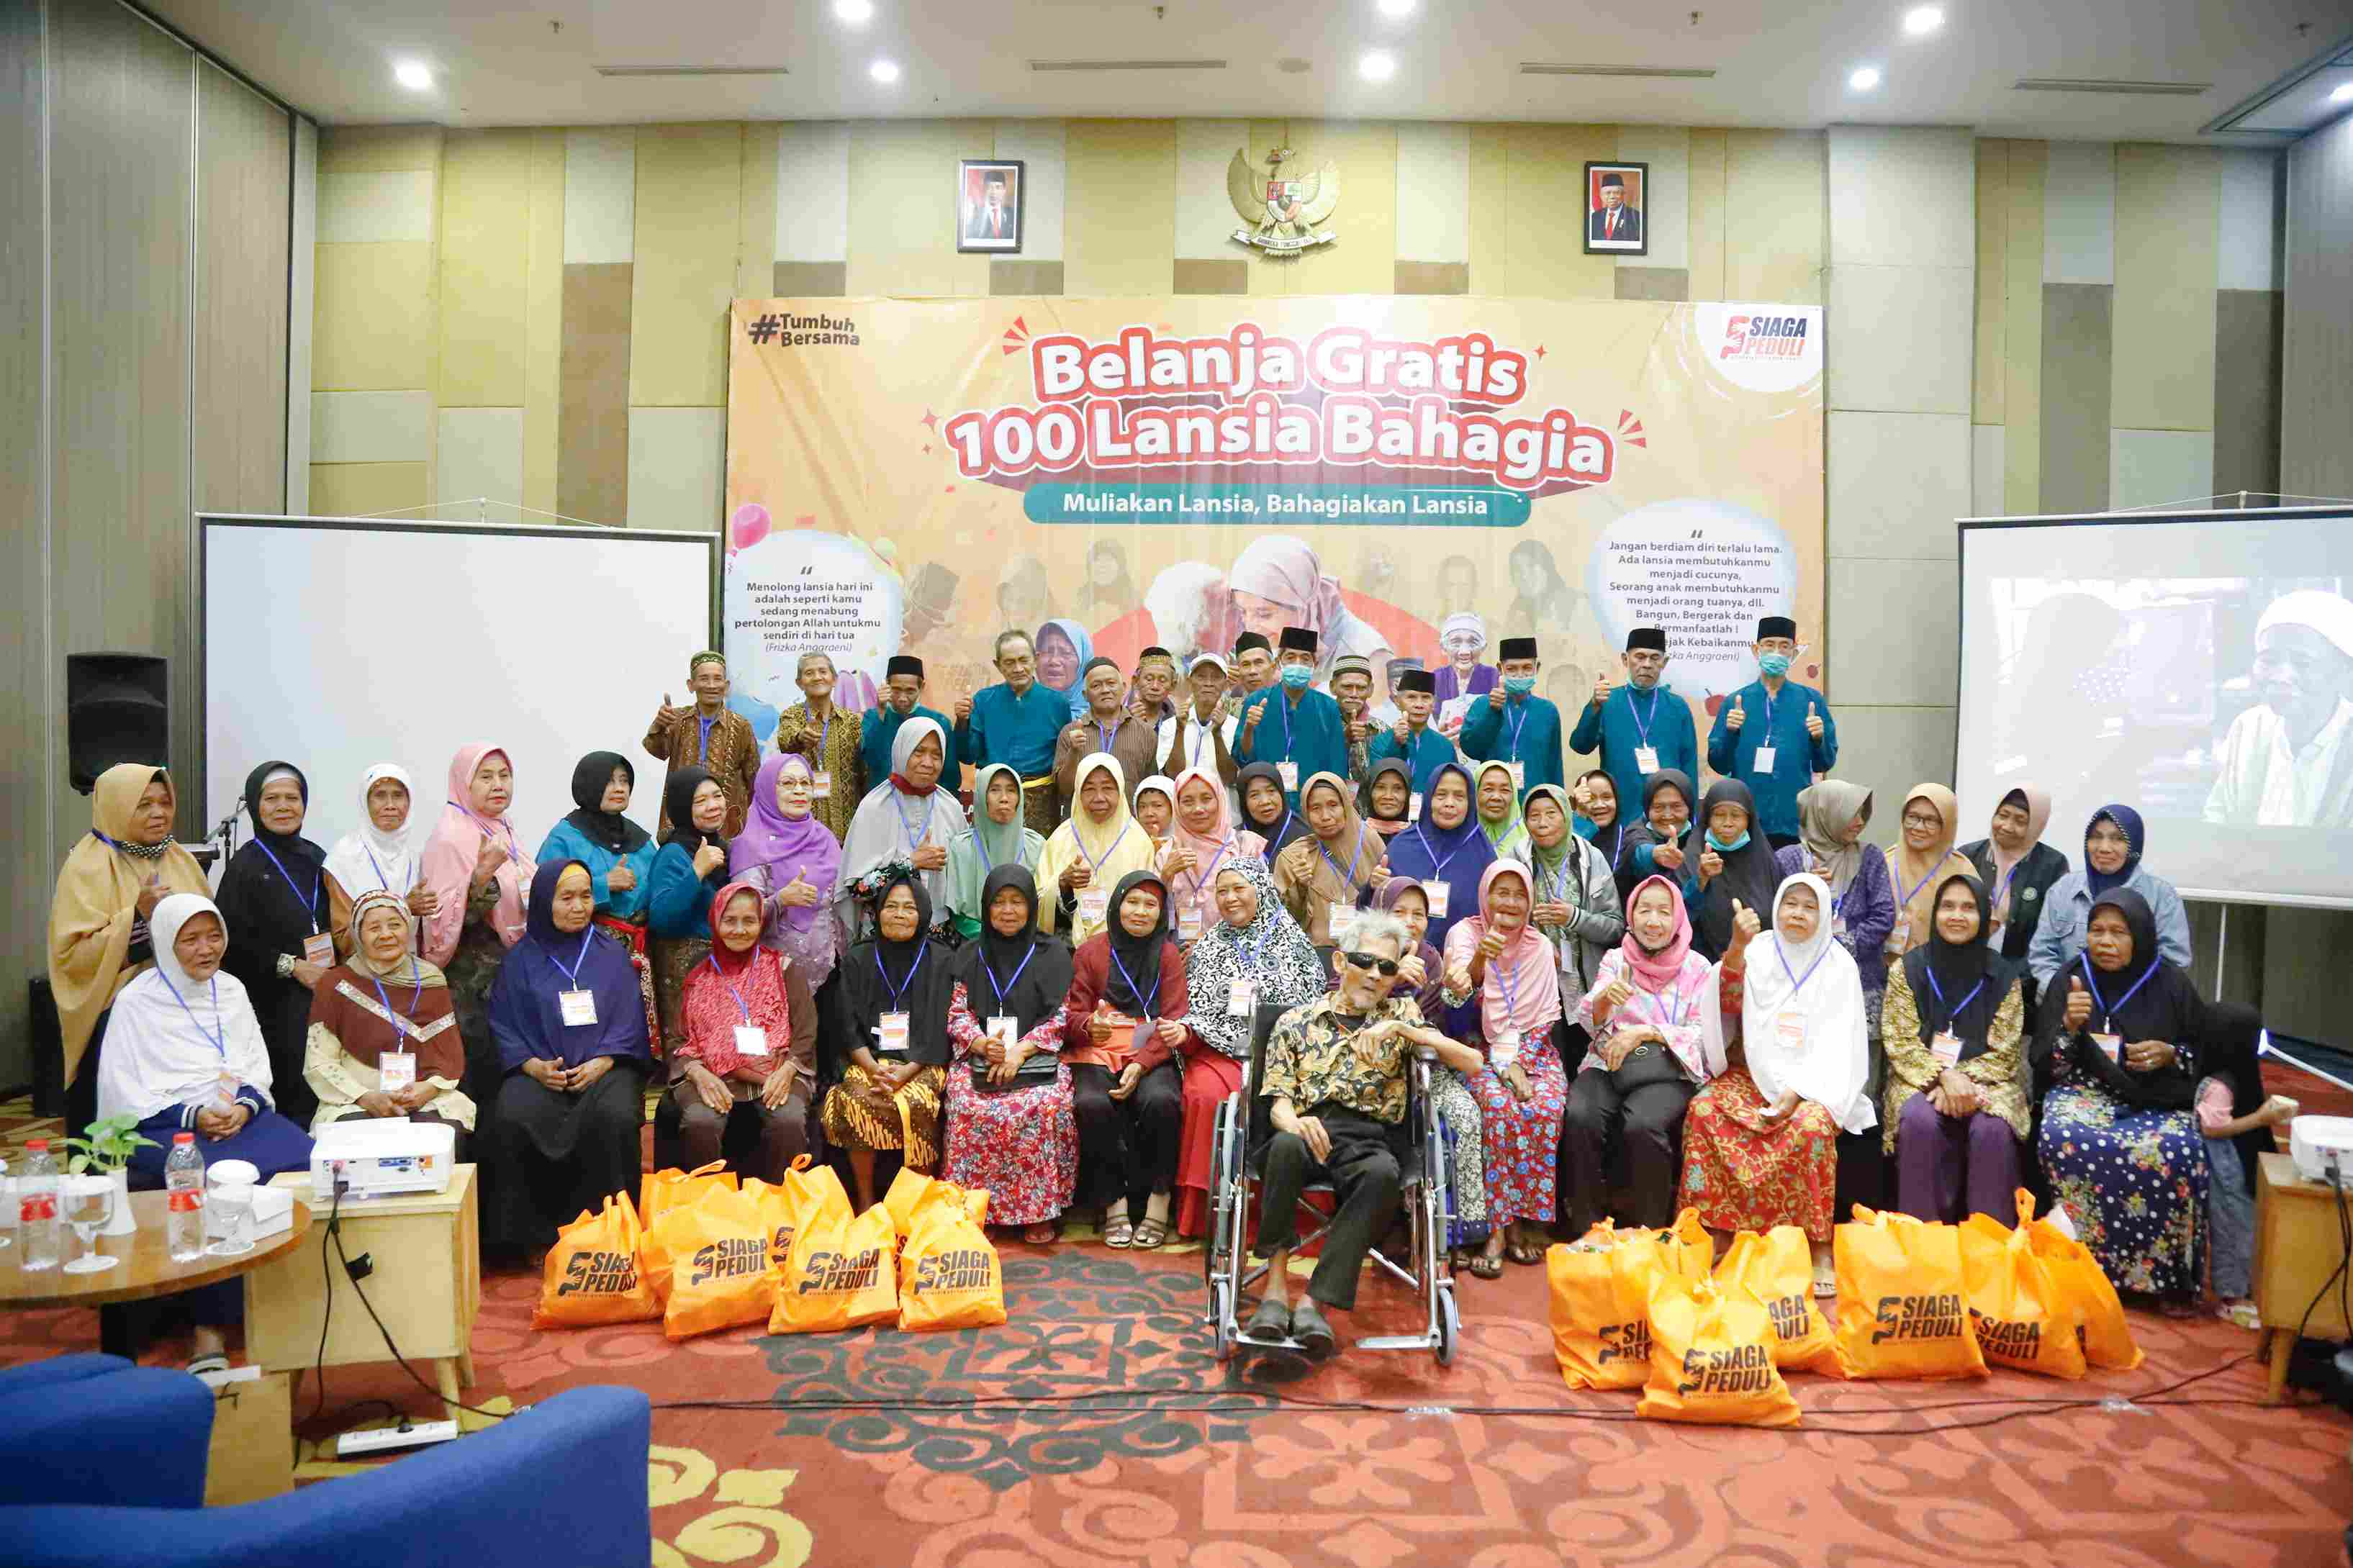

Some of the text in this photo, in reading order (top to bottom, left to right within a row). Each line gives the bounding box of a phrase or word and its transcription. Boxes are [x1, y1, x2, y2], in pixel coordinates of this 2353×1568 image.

[1751, 317, 1807, 337] SIAGA
[782, 332, 859, 347] Bersama
[1745, 337, 1805, 356] PEDULI
[1042, 331, 1519, 397] Belanja Gratis
[954, 400, 1604, 479] 100 Lansia Bahagia
[1063, 493, 1488, 519] Muliakan Lansia, Bahagiakan Lansia
[1609, 541, 1783, 553] Jangan berdiam diri terlalu lama.
[1619, 556, 1771, 567] Ada lansia membutuhkanmu
[1650, 568, 1741, 581] menjadi cucunya,
[747, 582, 873, 593] Menolong lansia hari ini
[1609, 582, 1779, 594] Seorang anak membutuhkanmu
[754, 594, 862, 605] adalah seperti kamu
[1627, 596, 1765, 609] menjadi orang tuanya, dll.
[760, 607, 859, 617] sedang menabung
[1636, 610, 1753, 622] Bangun, Bergerak dan
[735, 619, 881, 630] pertolongan Allah untukmu
[763, 631, 798, 640] sendiri
[801, 631, 811, 640] di
[814, 631, 835, 640] hari
[1687, 638, 1754, 648] Kebaikanmu
[765, 643, 796, 653] (Frizka
[1686, 651, 1740, 663] Anggraeni)
[715, 1254, 767, 1279] PEDUL
[828, 1248, 880, 1269] SIAGA
[939, 1249, 990, 1273] SIAGA
[823, 1266, 877, 1290] PEDULI
[935, 1268, 990, 1290] PEDULI
[1768, 1295, 1807, 1320] AGA
[1902, 1295, 1962, 1319] SIAGA
[1773, 1315, 1810, 1341] ULI
[1898, 1318, 1963, 1339] PEDULI
[1979, 1316, 2039, 1343] SIAGA
[1710, 1346, 1768, 1371] SIAGA
[1704, 1369, 1771, 1393] PEDULI
